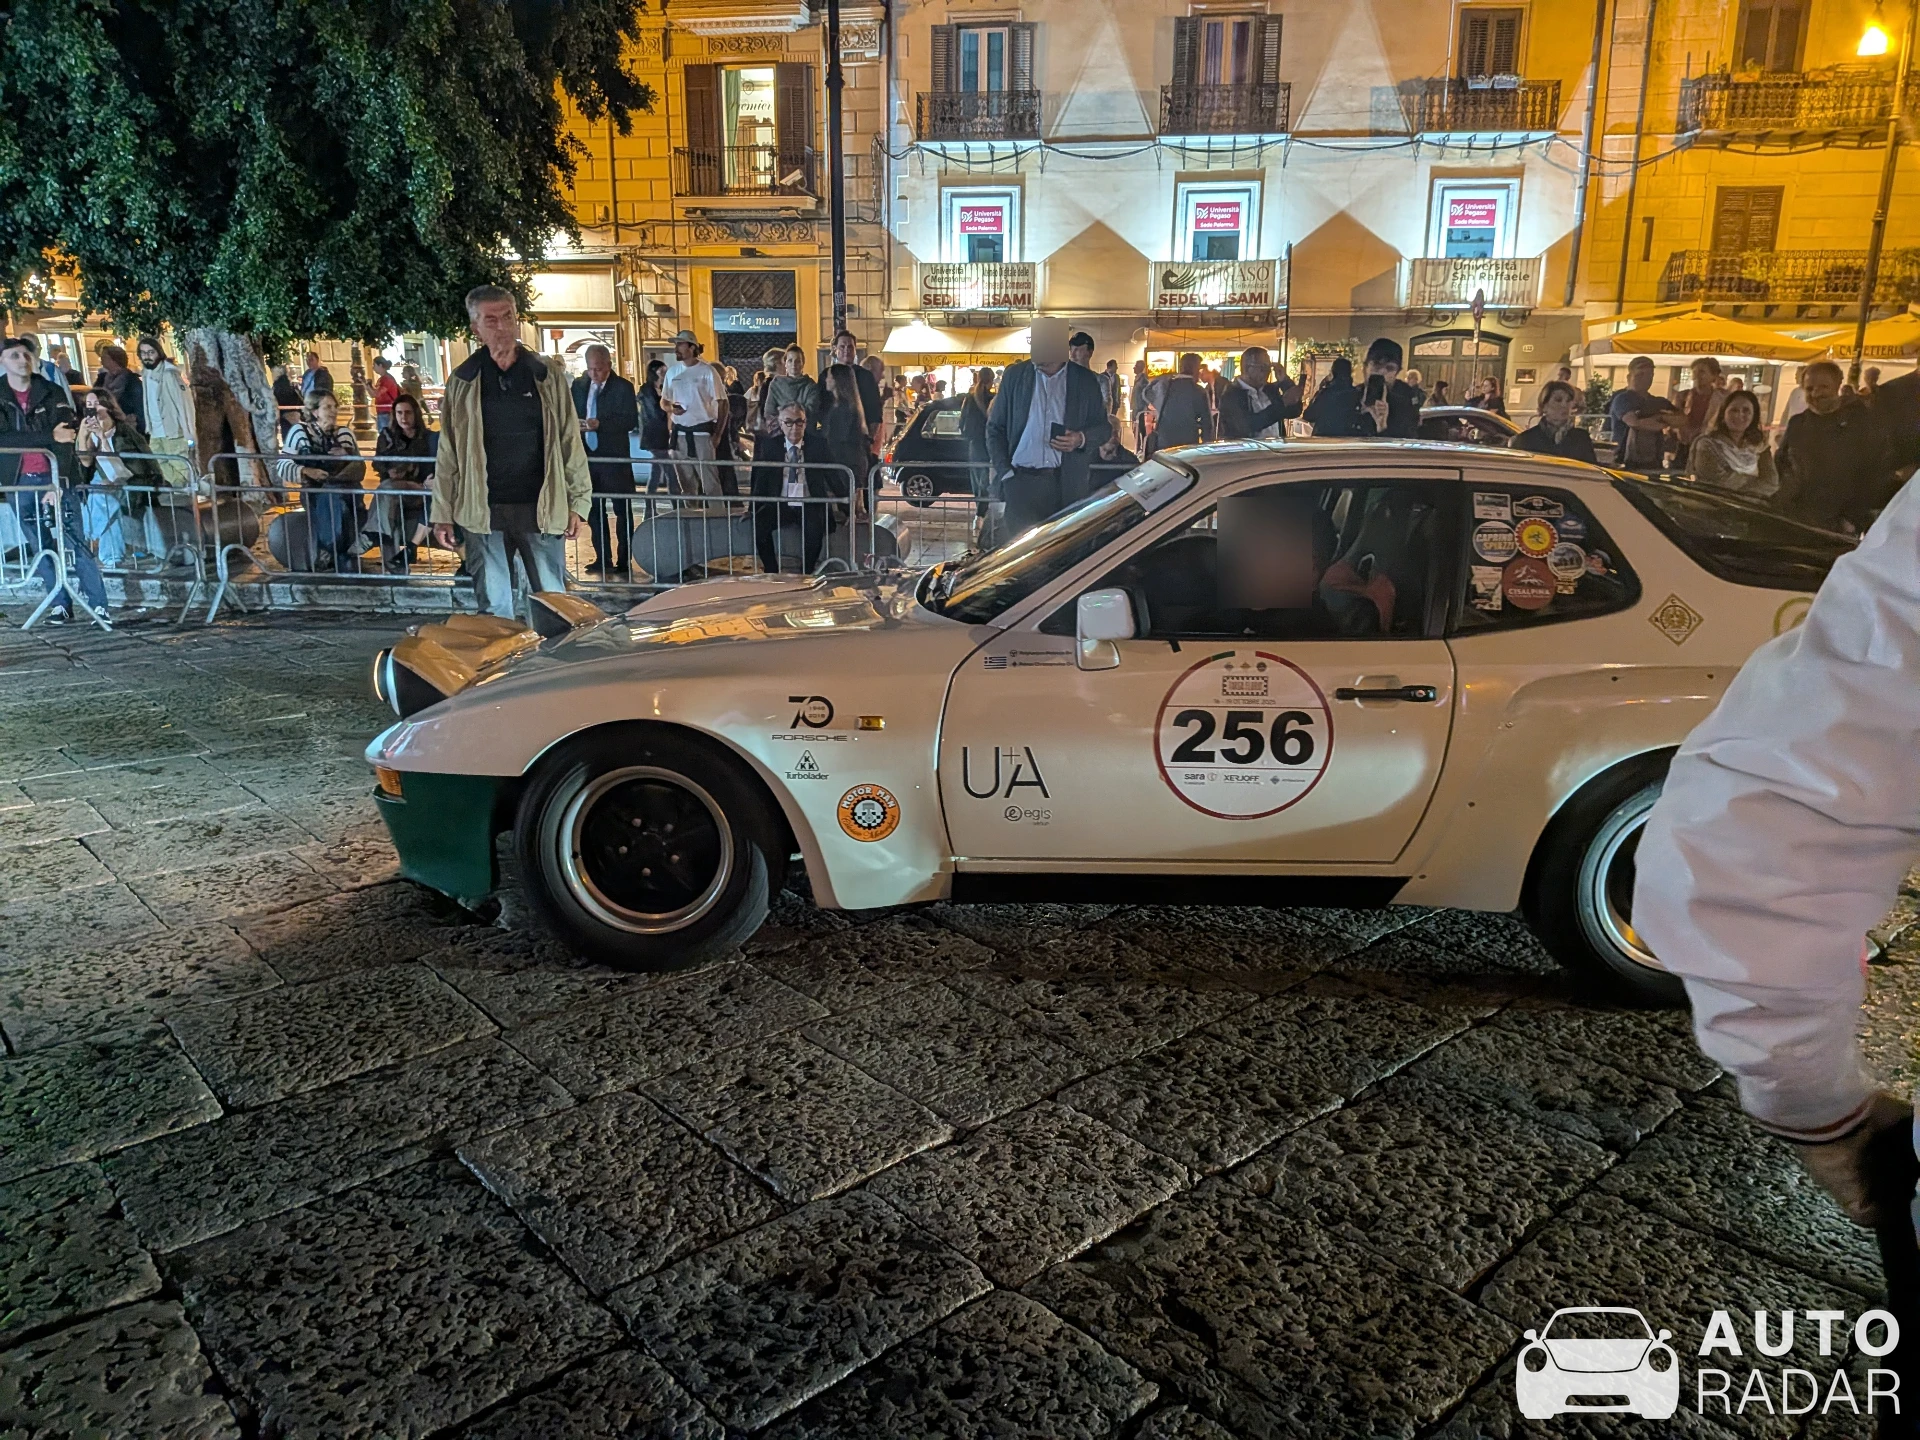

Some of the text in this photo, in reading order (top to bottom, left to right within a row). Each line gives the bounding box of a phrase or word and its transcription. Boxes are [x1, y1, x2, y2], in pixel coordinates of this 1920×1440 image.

[930, 266, 964, 275] Università
[1453, 260, 1517, 271] Università
[930, 276, 972, 285] Mercatorum
[1452, 271, 1530, 281] San Raffaele
[922, 294, 1032, 306] SEDE ESAMI
[1158, 293, 1198, 305] SEDE
[729, 311, 780, 326] The man
[1660, 341, 1735, 353] PASTICCERIA
[1840, 345, 1904, 356] CAETTERIA
[935, 354, 1005, 366] Ricami Veronica
[788, 696, 834, 729] 70
[1170, 709, 1314, 765] 256
[785, 772, 829, 780] Turbolader
[841, 786, 896, 809] MOTOR MAN
[1024, 806, 1052, 820] egis
